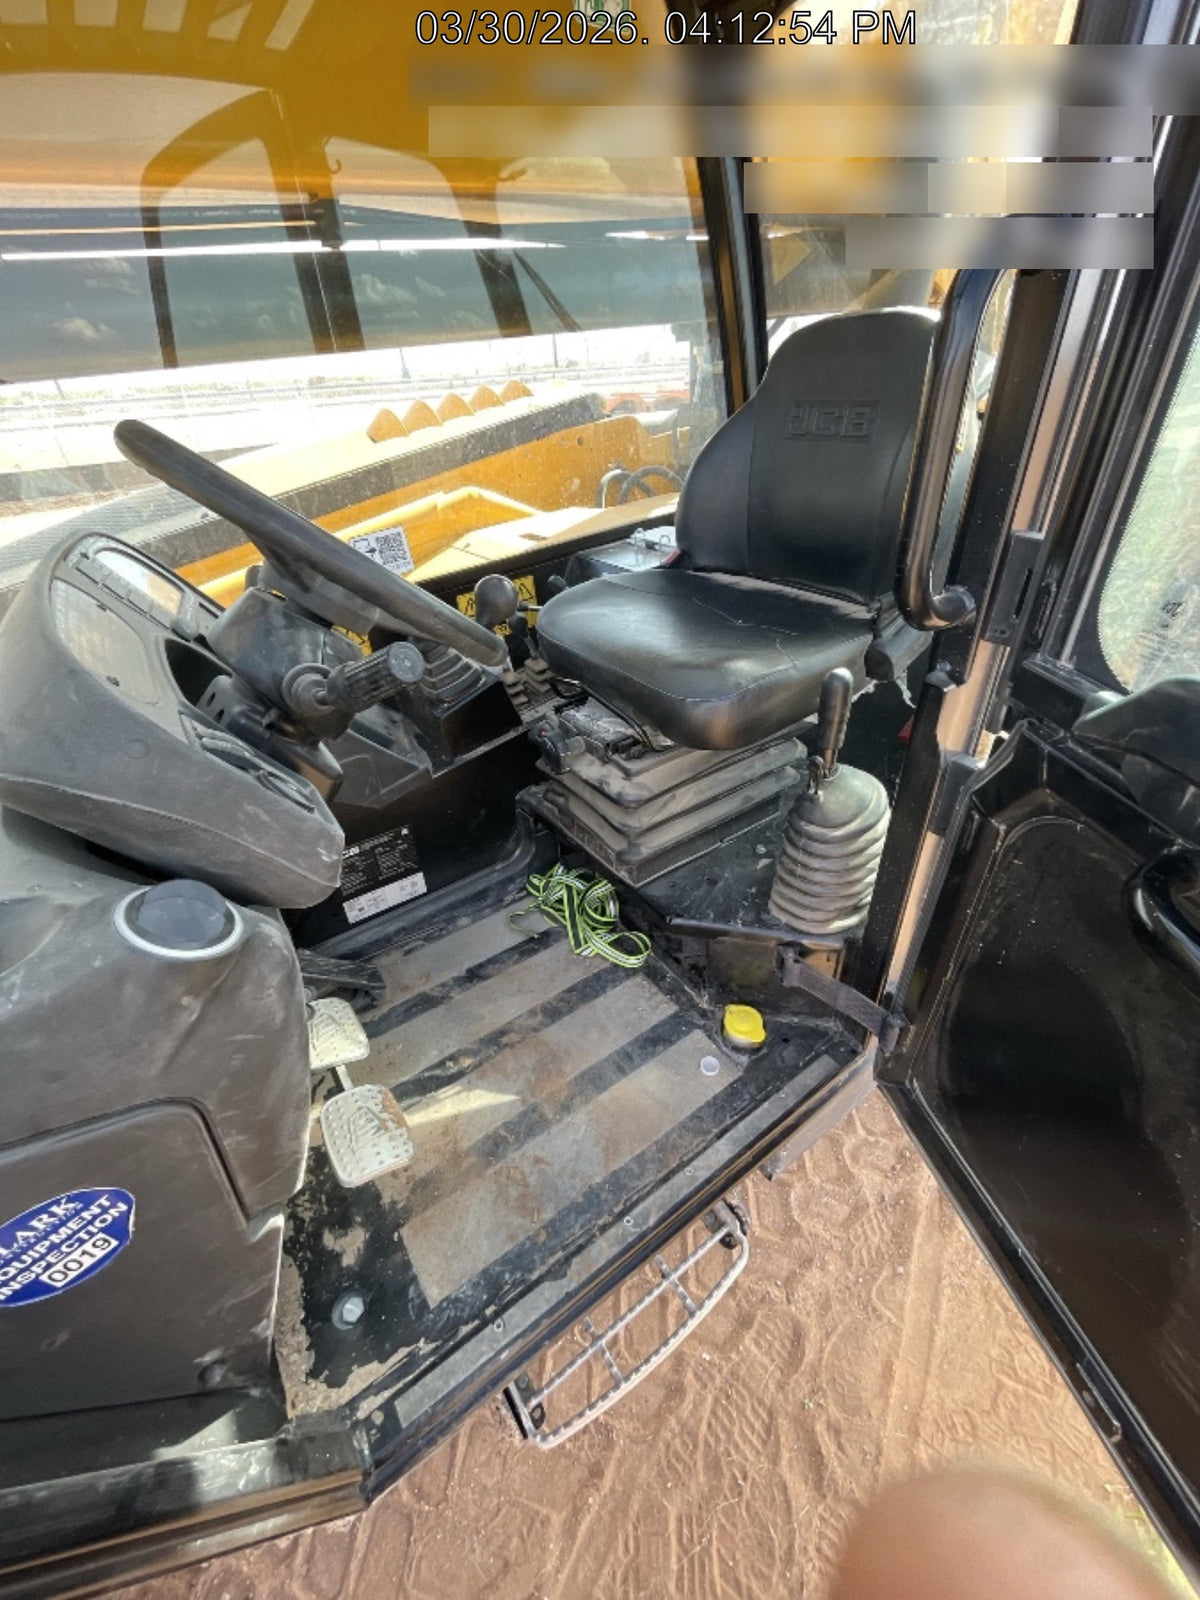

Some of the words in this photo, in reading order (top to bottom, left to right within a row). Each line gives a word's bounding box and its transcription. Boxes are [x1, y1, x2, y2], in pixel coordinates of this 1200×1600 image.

[788, 405, 872, 437] JCB
[0, 1197, 79, 1255] LARK
[0, 1194, 111, 1282] QUIPMENT
[48, 1237, 112, 1283] 0019
